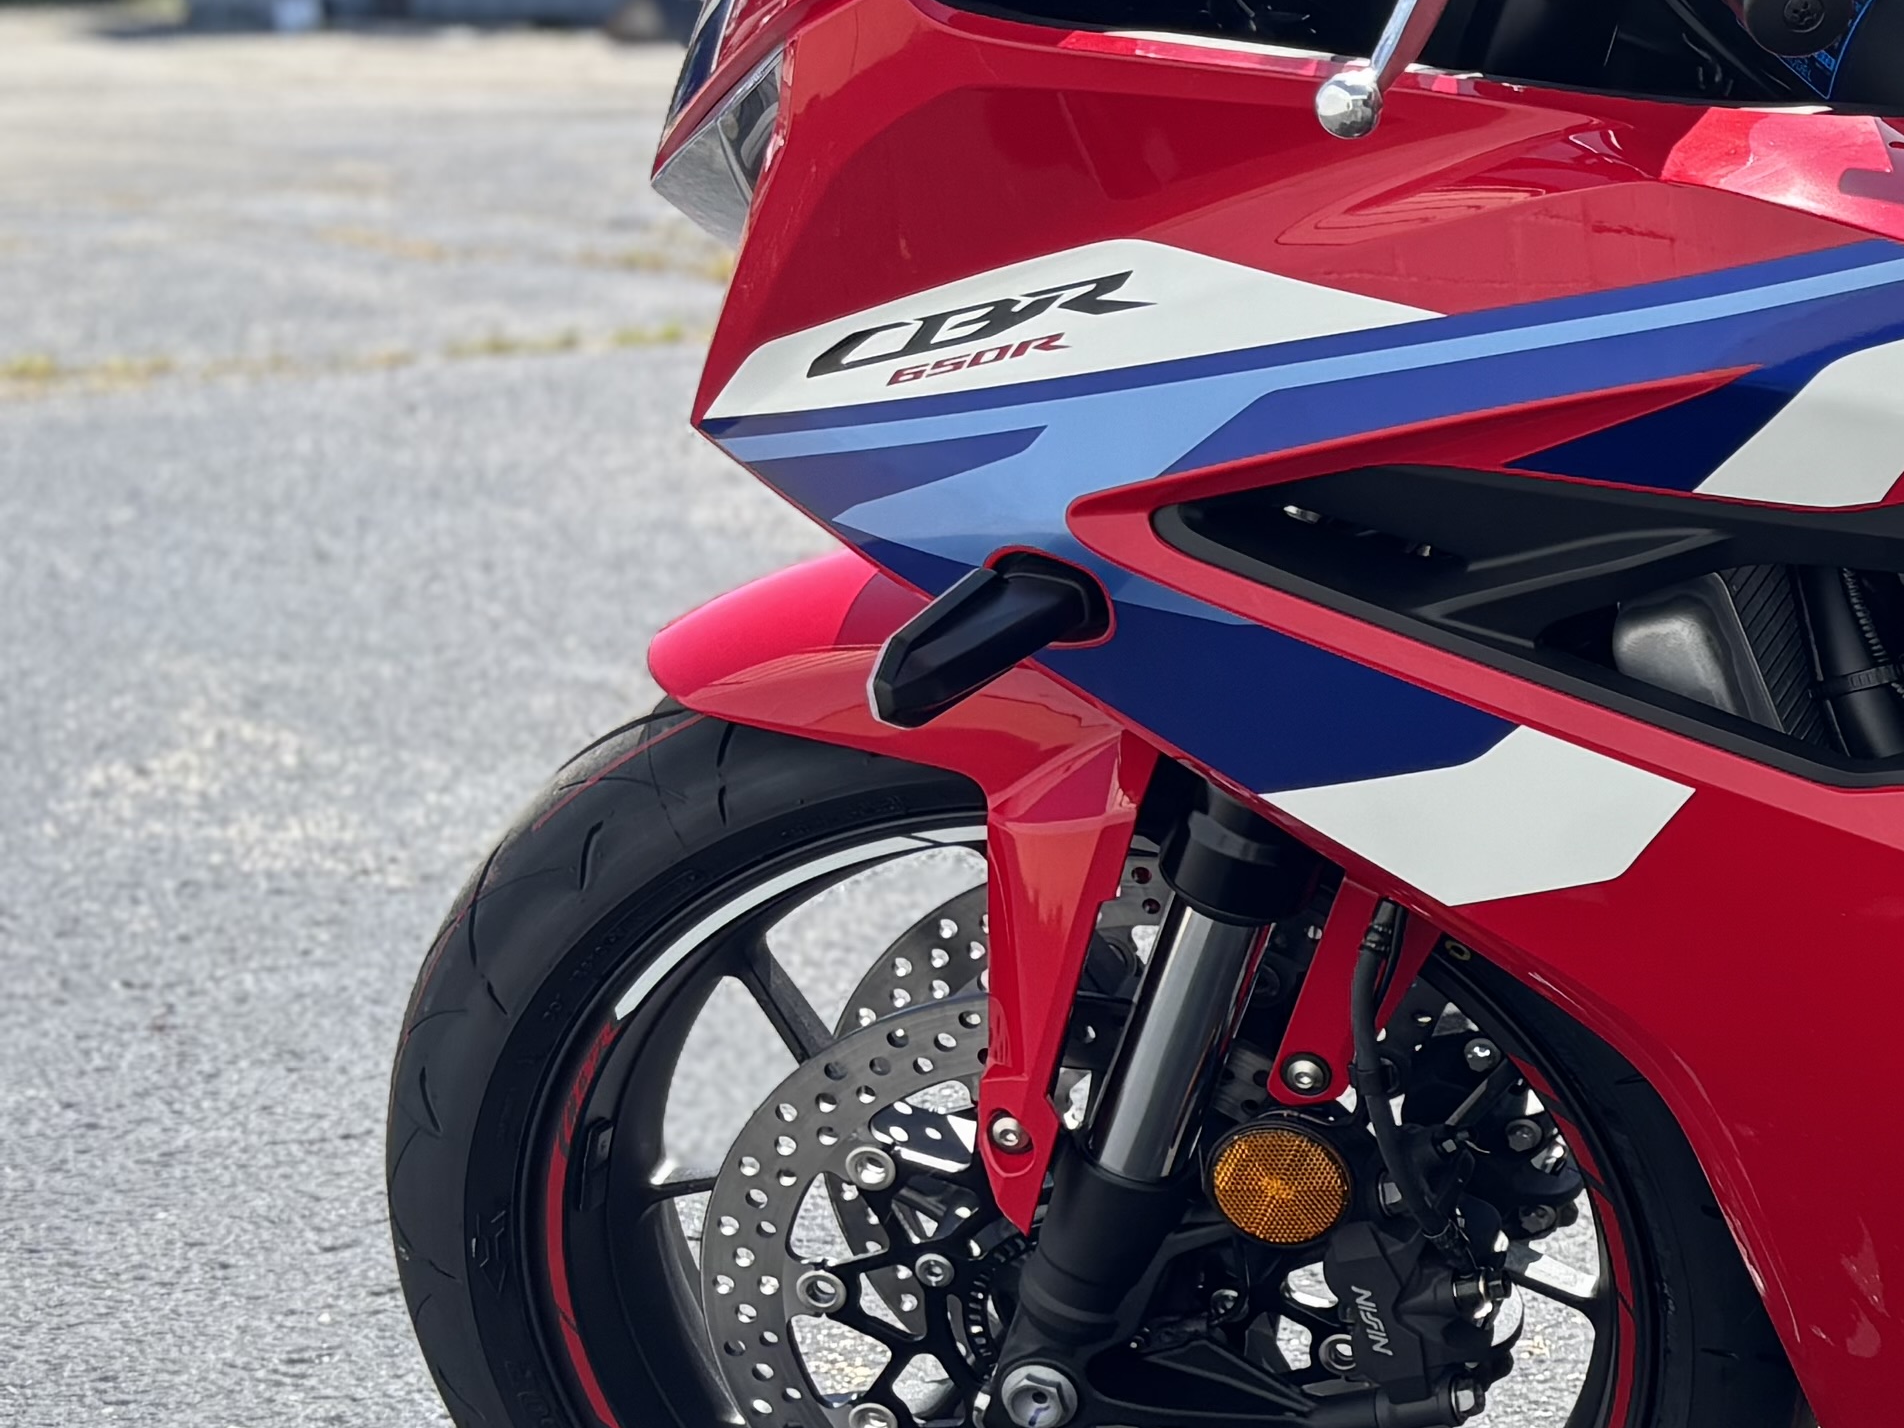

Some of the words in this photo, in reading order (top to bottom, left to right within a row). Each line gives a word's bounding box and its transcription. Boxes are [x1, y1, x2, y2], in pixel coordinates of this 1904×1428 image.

[805, 269, 1157, 379] CBR
[886, 332, 1071, 387] 650R
[1350, 1284, 1394, 1357] NISSIN
